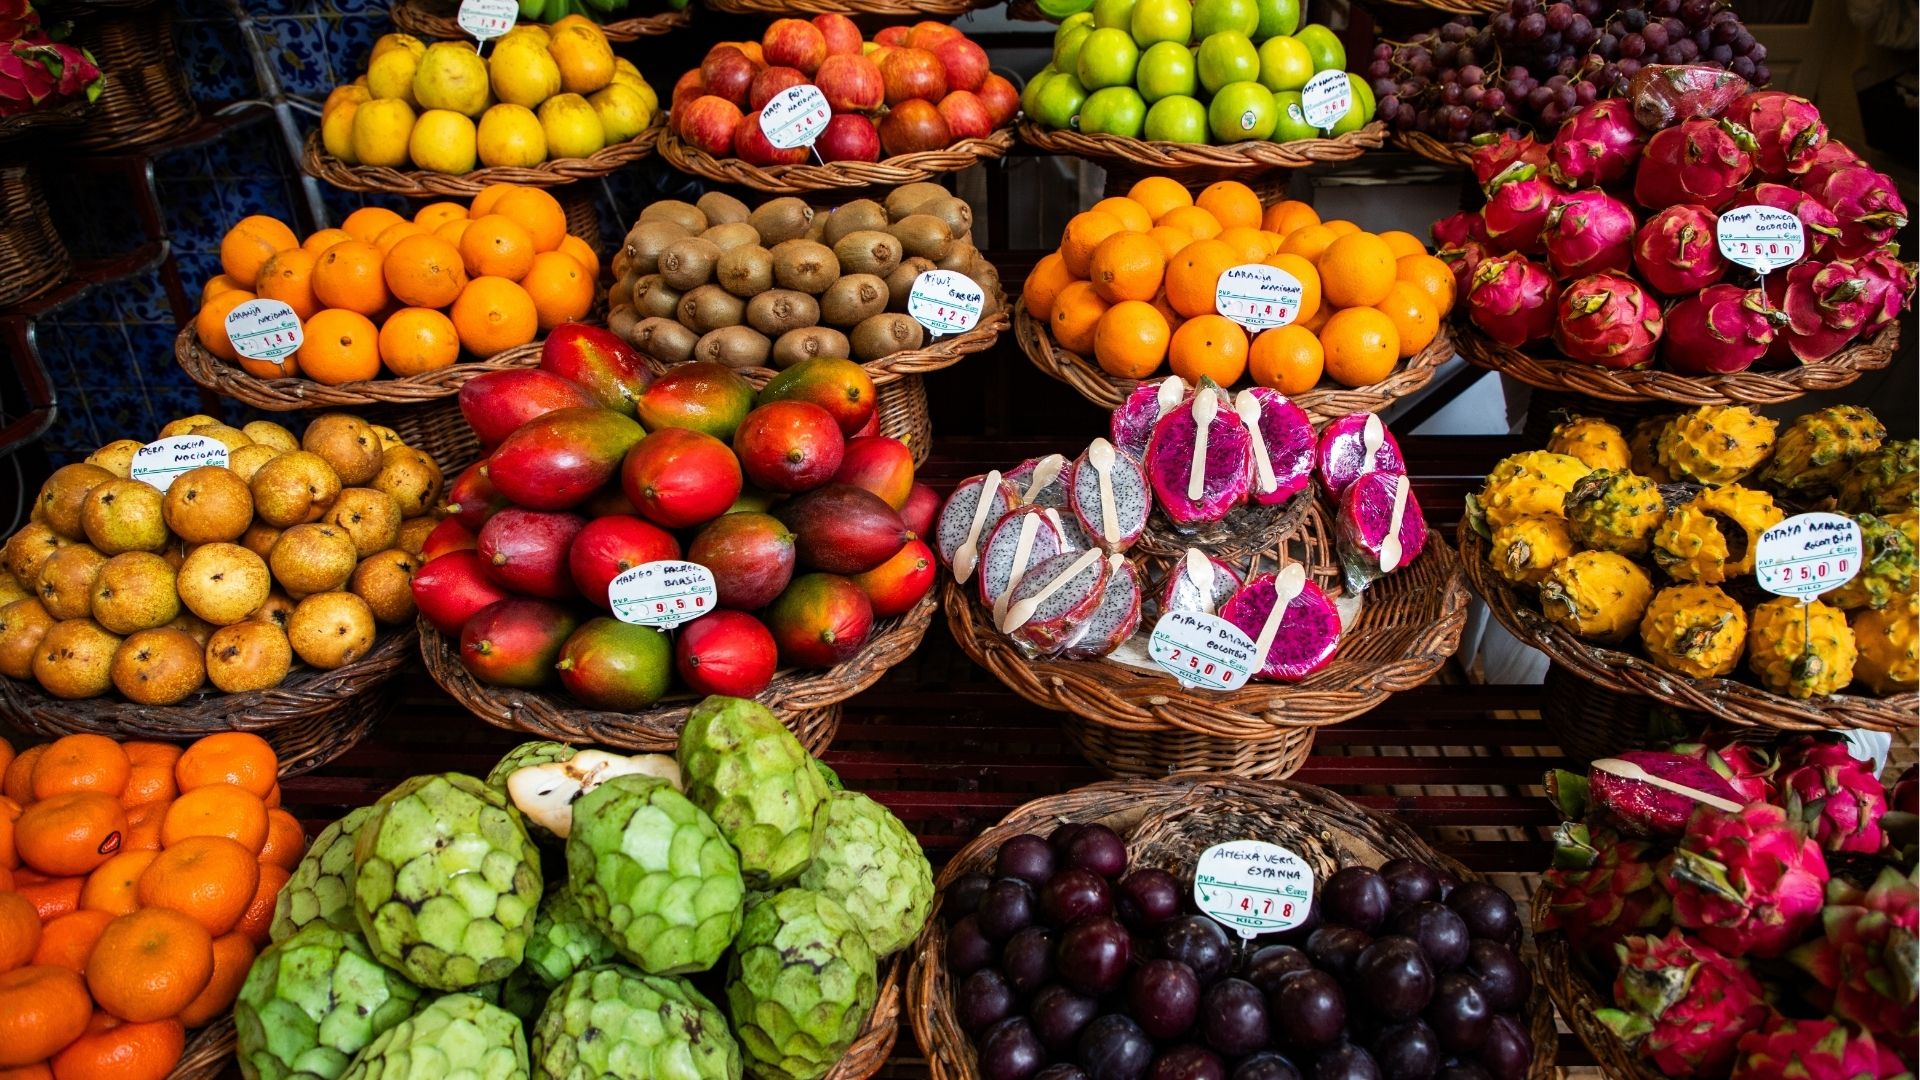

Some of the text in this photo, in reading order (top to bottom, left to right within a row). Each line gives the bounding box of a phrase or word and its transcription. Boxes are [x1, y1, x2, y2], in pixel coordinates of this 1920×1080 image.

[258, 308, 293, 324] NACIONAL
[138, 445, 164, 457] PERA
[174, 449, 227, 462] NACIONAL
[1763, 524, 1801, 543] PITAYA
[616, 570, 653, 585] MANGO
[1783, 559, 1846, 581] 25,00
[1797, 584, 1821, 592] KILO
[656, 596, 704, 614] 9,50
[1171, 613, 1258, 655] PITAYA BRANCA
[1206, 640, 1248, 660] COLOMBIA
[1169, 649, 1232, 682] 25,00
[1179, 670, 1202, 681] KILO
[1213, 847, 1260, 861] AMEIXA
[1247, 866, 1301, 880] ESPANHA
[1240, 897, 1292, 917] 4,78
[1236, 917, 1263, 925] KILO
